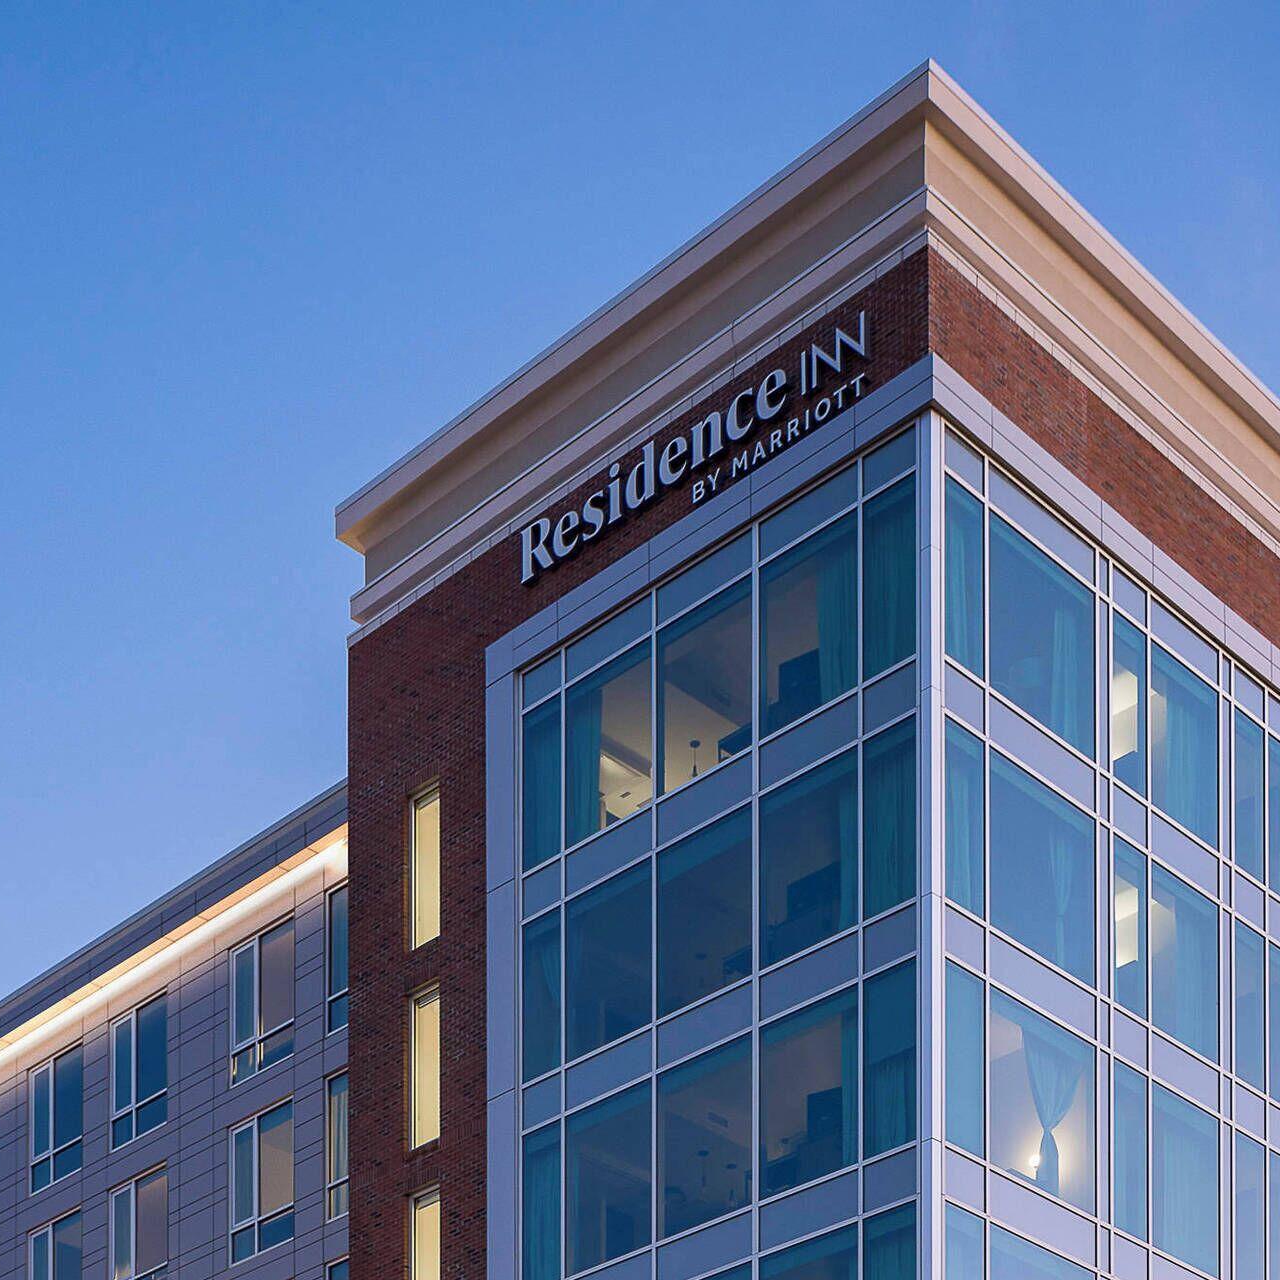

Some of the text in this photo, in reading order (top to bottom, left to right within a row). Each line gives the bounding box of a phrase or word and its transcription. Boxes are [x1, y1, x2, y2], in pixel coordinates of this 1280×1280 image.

[520, 310, 869, 585] Residence INN
[692, 373, 868, 504] BY MARRIOTT
